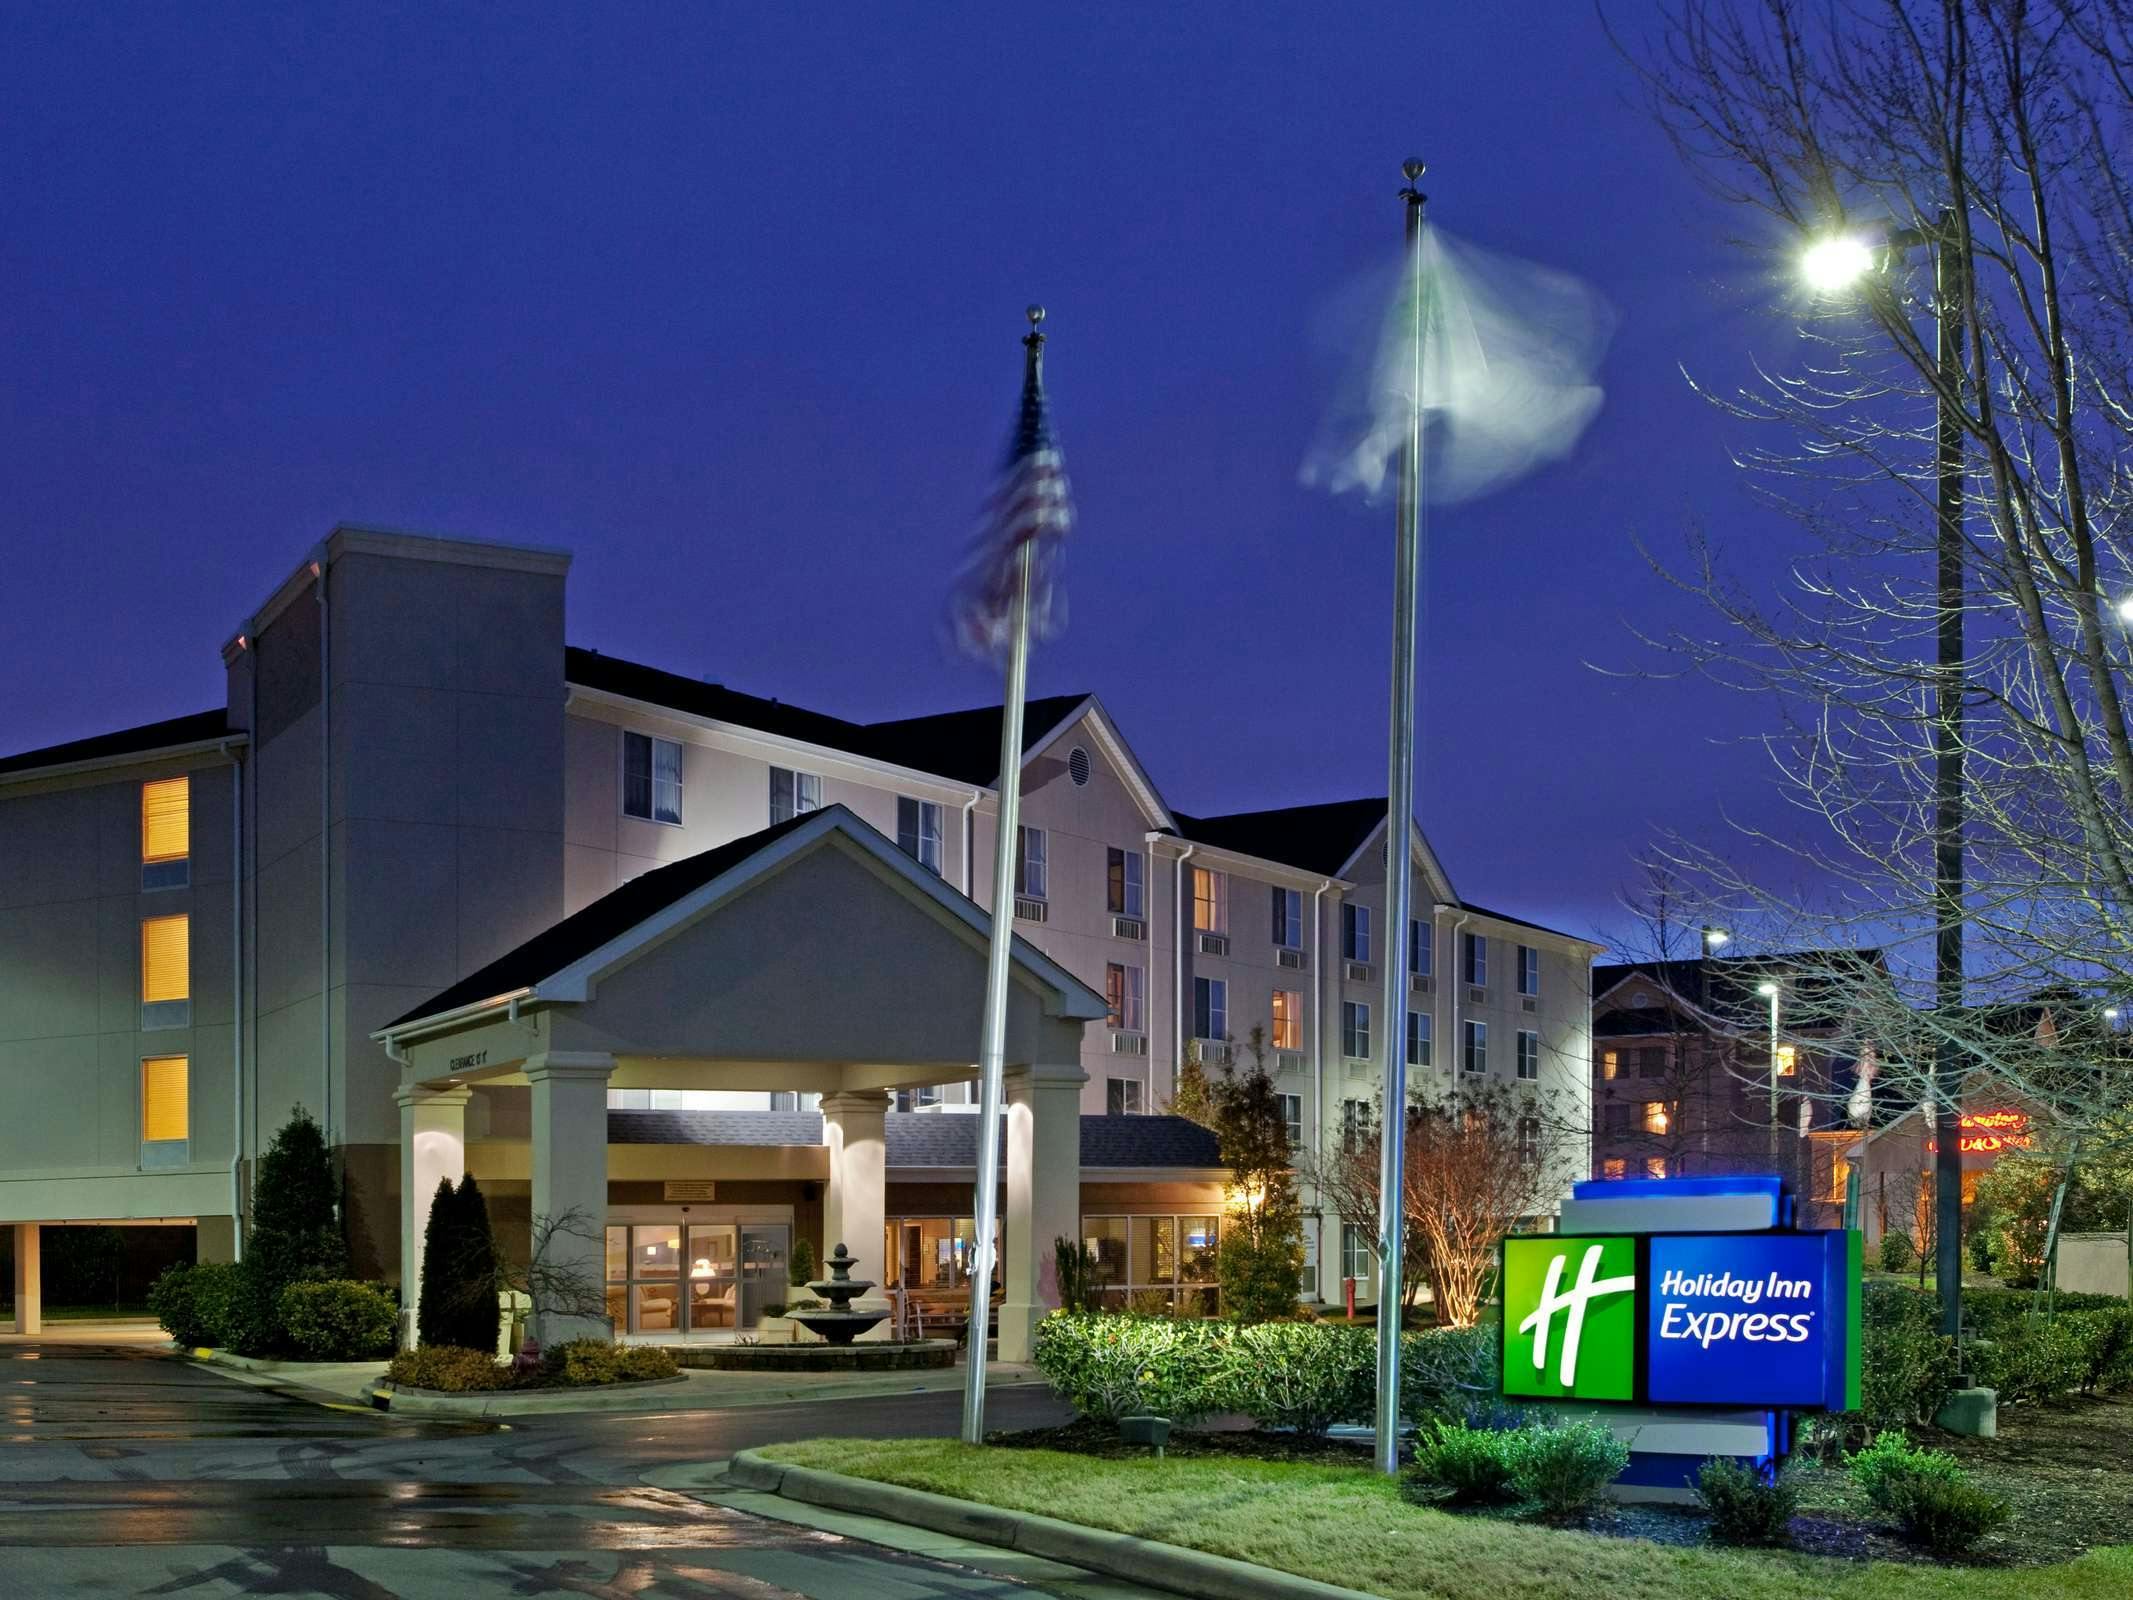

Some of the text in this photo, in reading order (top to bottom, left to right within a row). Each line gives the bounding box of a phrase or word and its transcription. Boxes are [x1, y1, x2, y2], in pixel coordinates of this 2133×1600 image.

[1660, 1270, 1812, 1304] Holiday Inn
[1519, 1244, 1635, 1387] H
[1660, 1303, 1811, 1350] Express
